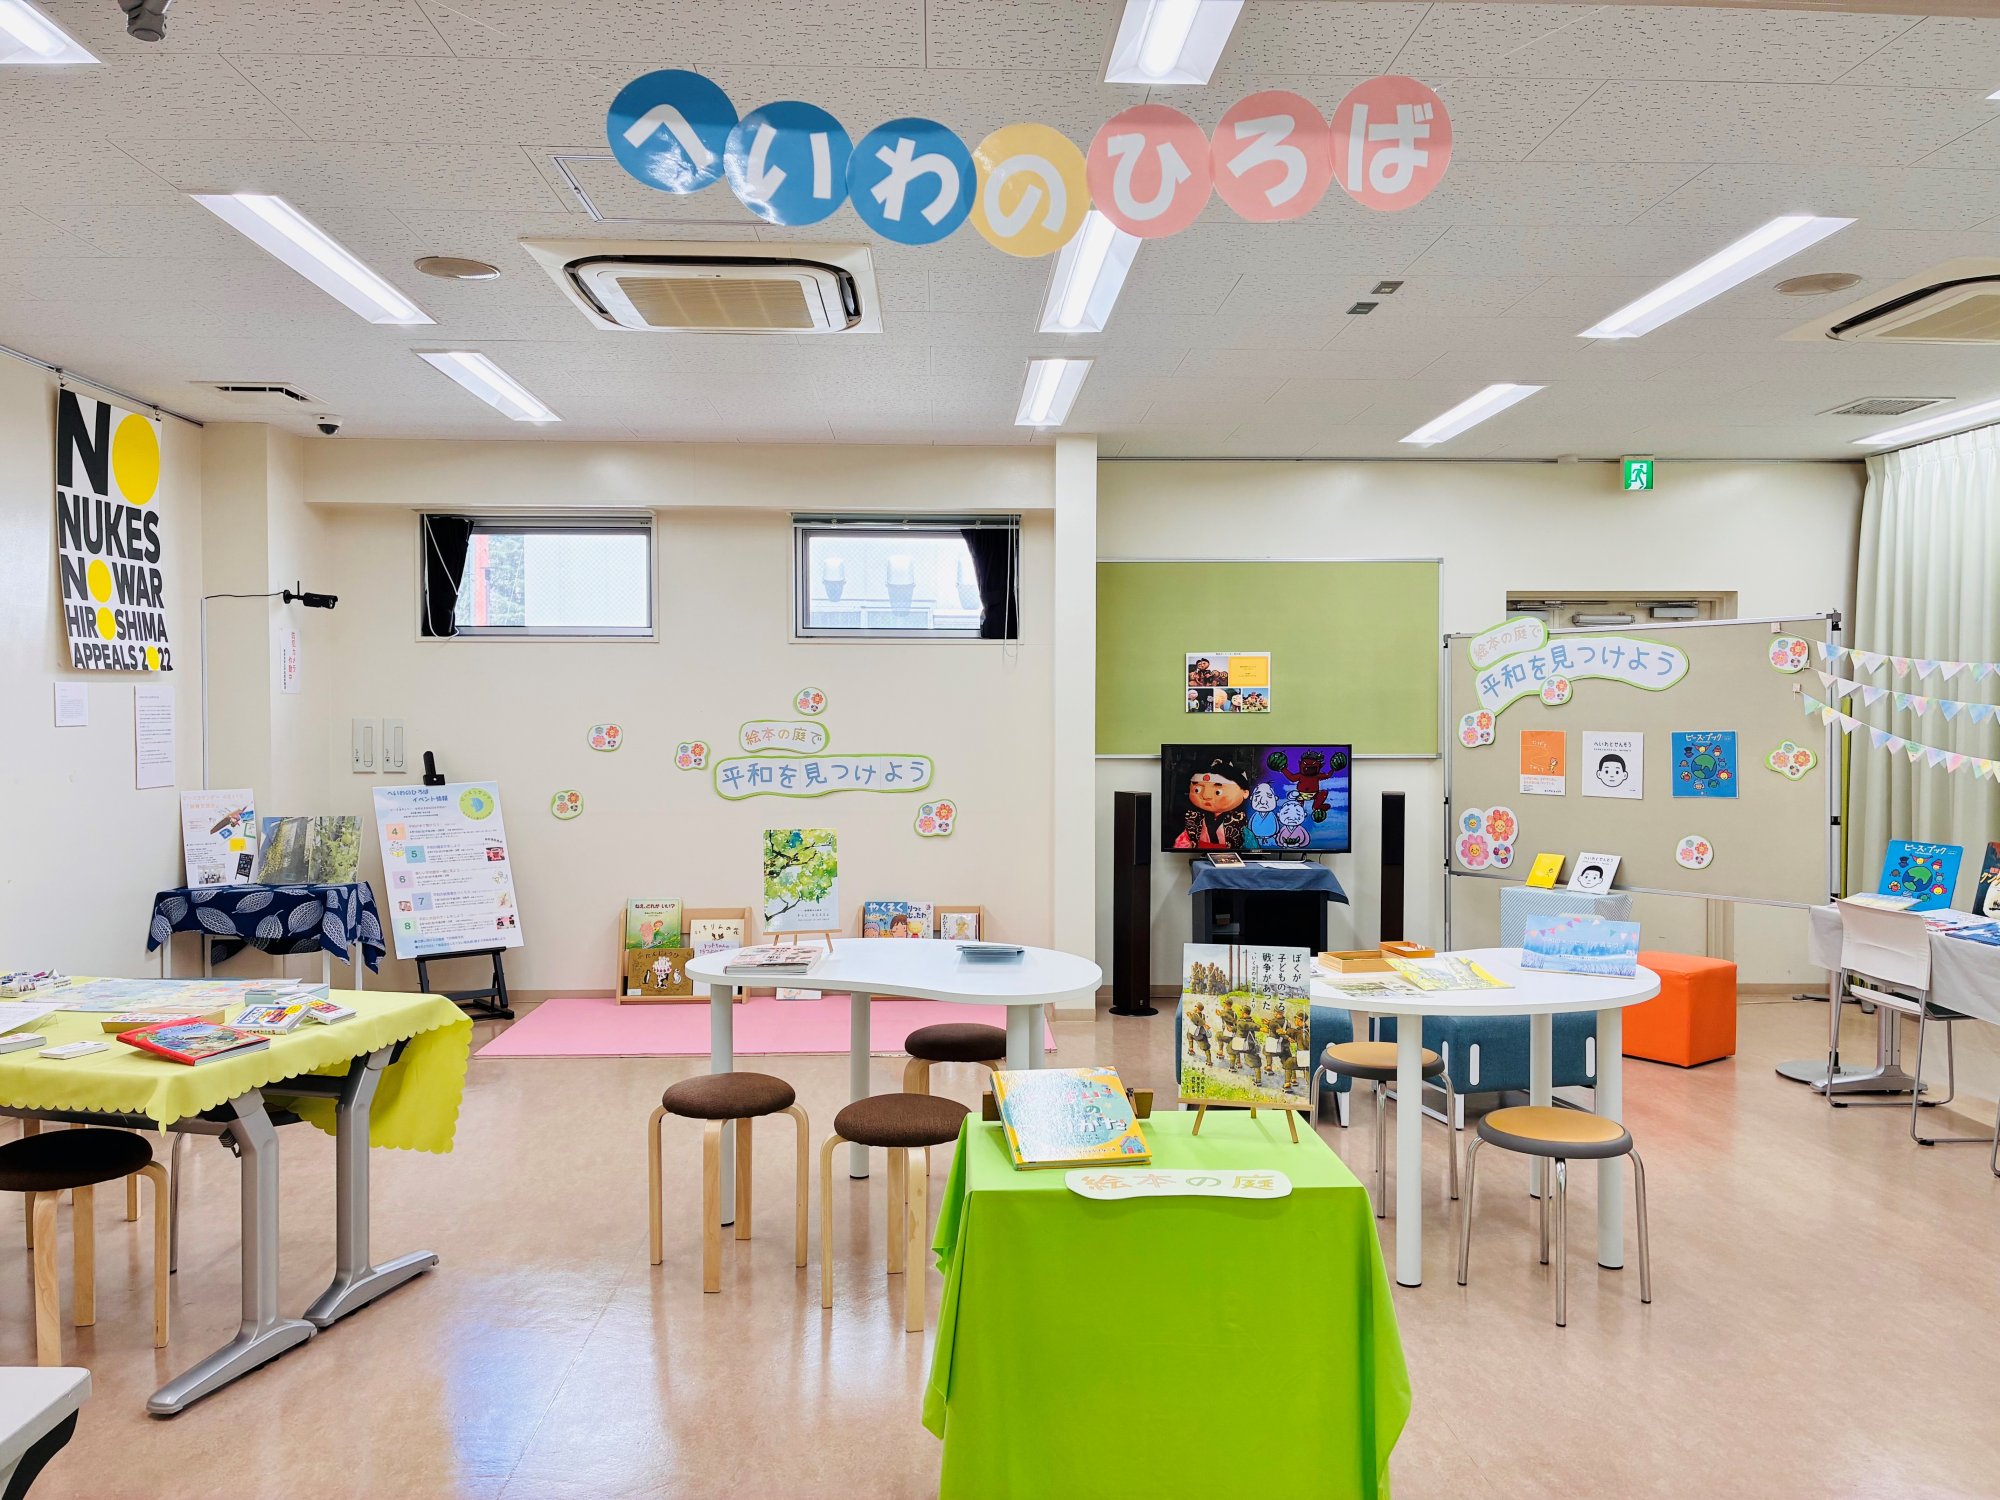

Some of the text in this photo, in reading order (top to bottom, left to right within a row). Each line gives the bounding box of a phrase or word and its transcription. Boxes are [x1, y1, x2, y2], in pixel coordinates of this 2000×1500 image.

[623, 102, 1434, 238] へいわのひろば
[58, 491, 161, 564] NUKES
[61, 554, 165, 609] NO WAR
[67, 604, 169, 643] HIROSHIMA
[74, 643, 173, 671] APPEALS 2022
[1473, 623, 1542, 662] 絵本の庭で
[1481, 644, 1676, 699] 平和を見つけよう
[745, 727, 823, 746] 絵本の庭で
[721, 761, 925, 790] 平和を見つけよう
[411, 850, 418, 858] 5
[418, 897, 425, 906] 7
[868, 902, 903, 912] やくそく
[1262, 952, 1272, 1010] 戦争があった
[1277, 953, 1286, 1012] 子どものころ
[1292, 953, 1302, 982] ぼくが
[1081, 1173, 1275, 1191] 絵本の庭
